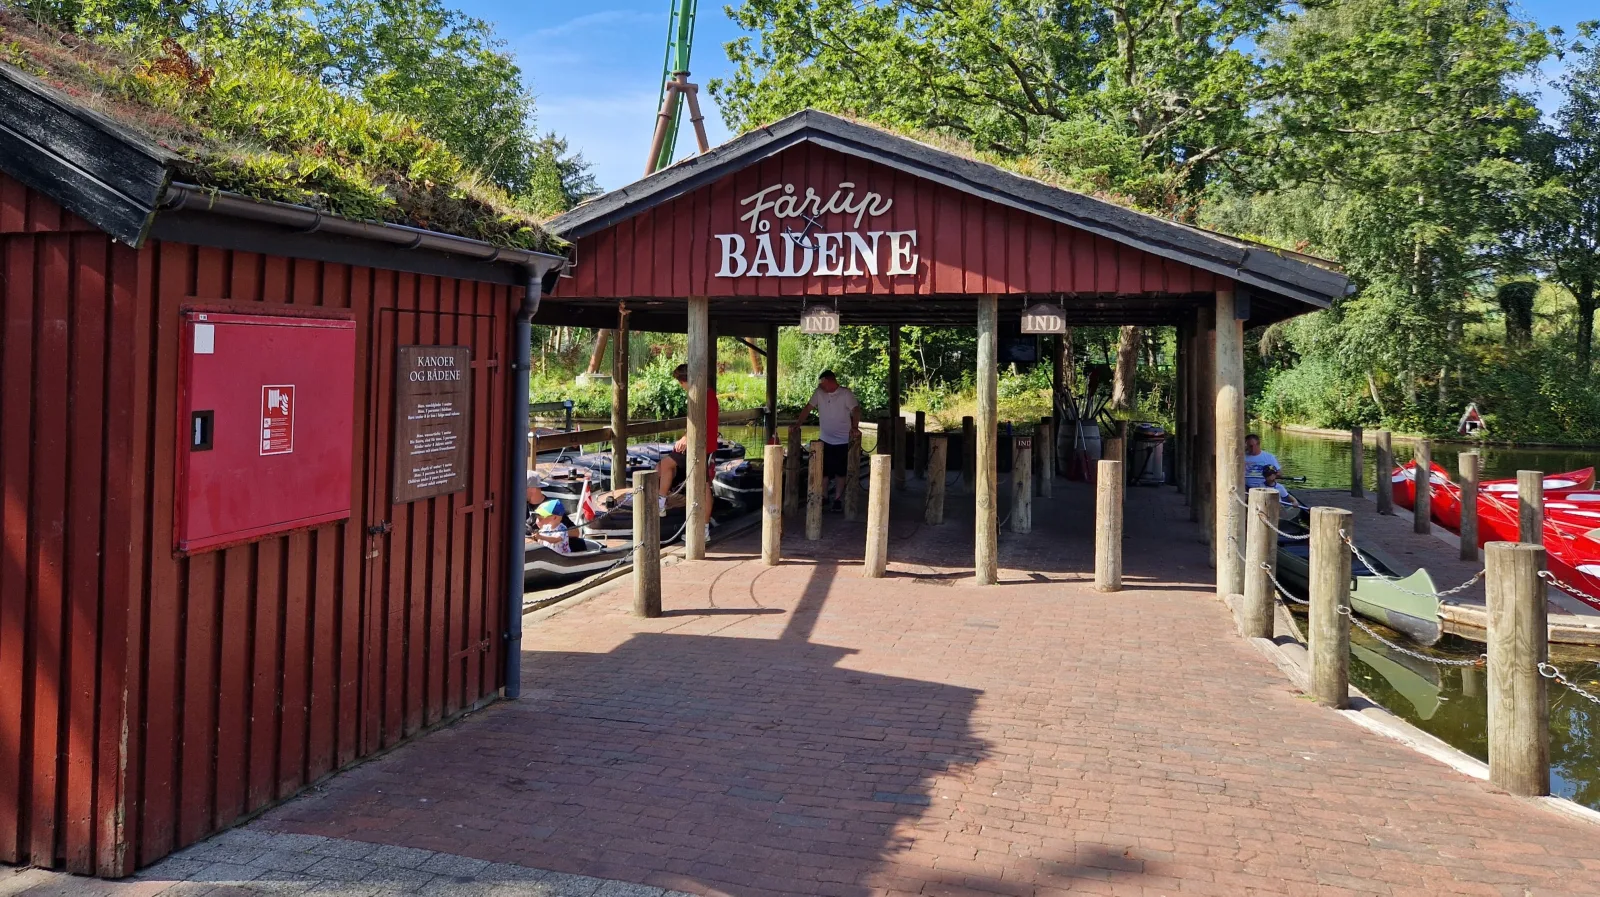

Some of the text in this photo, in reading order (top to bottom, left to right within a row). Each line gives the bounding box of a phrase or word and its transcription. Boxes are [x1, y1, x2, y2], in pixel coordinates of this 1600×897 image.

[714, 219, 919, 278] BÅDENE
[804, 316, 835, 331] IND
[1025, 315, 1061, 331] IND
[417, 356, 455, 367] KANOER
[409, 368, 461, 382] OG BÅDENE
